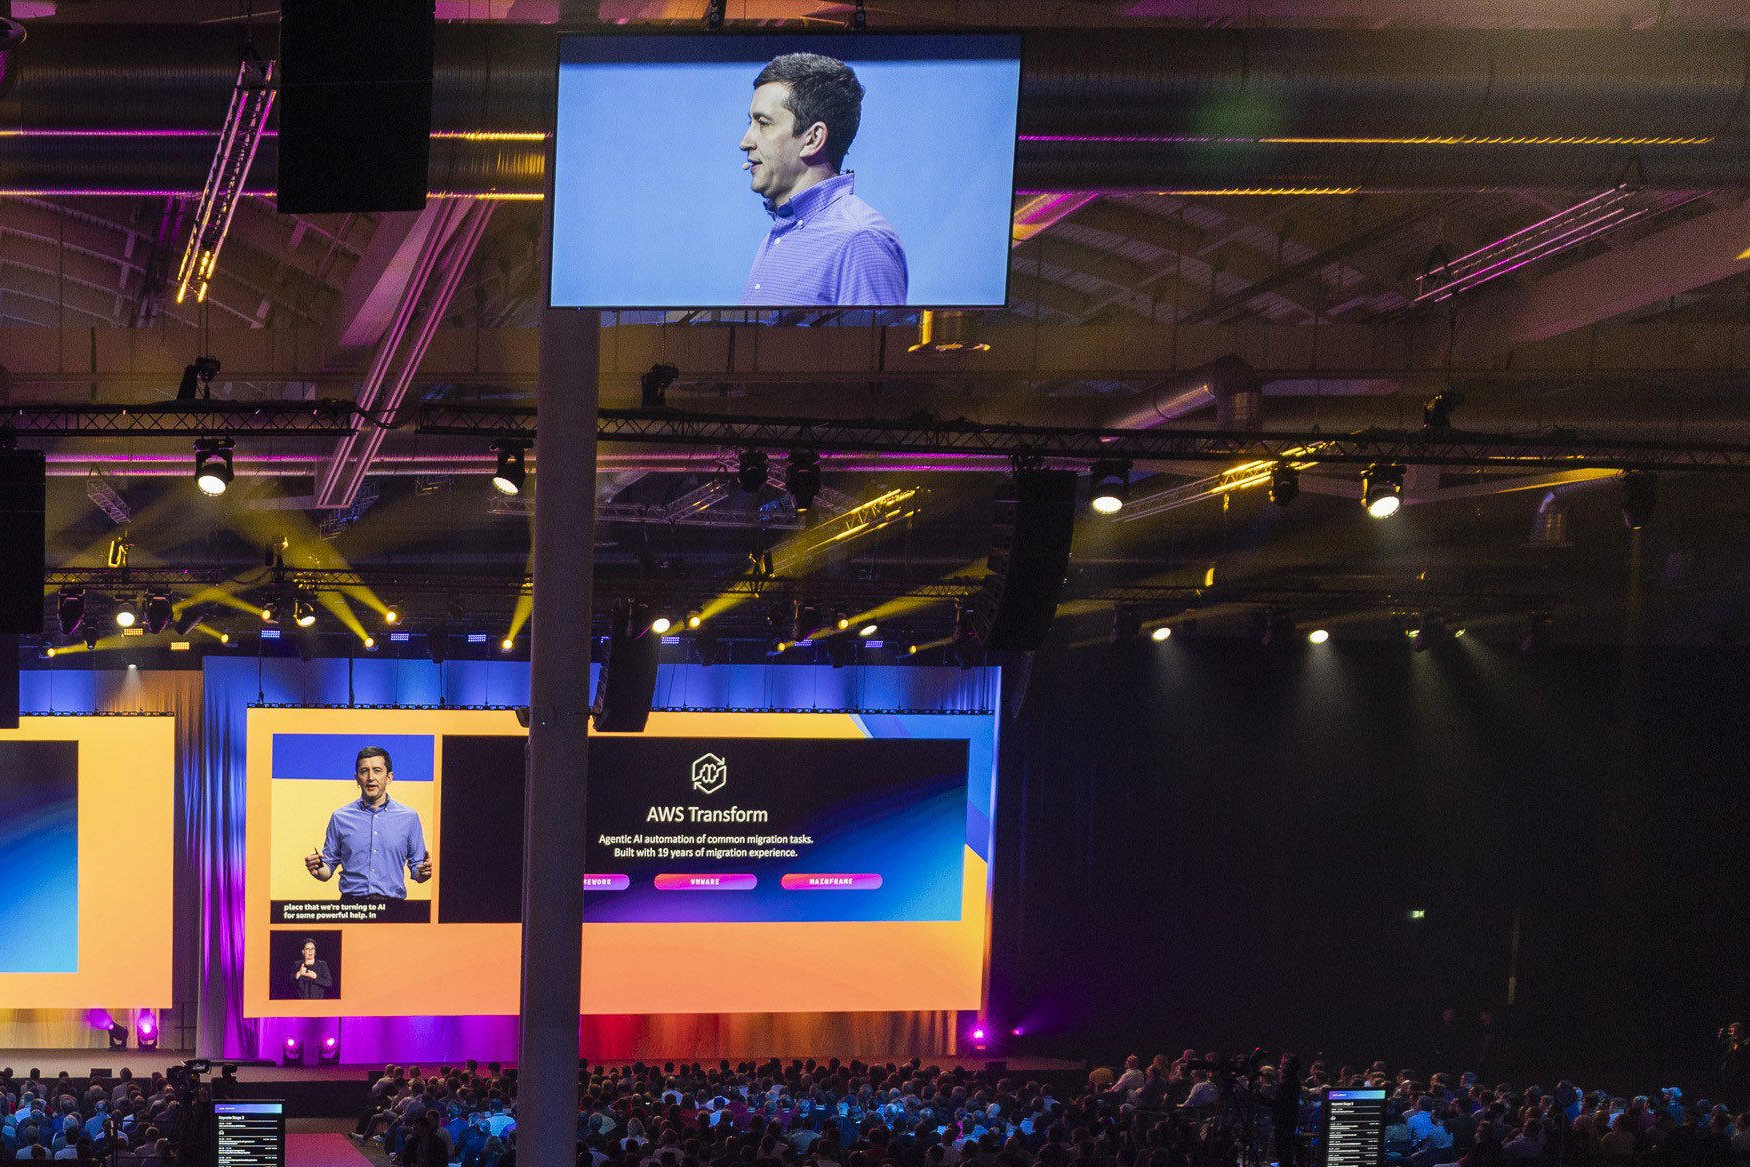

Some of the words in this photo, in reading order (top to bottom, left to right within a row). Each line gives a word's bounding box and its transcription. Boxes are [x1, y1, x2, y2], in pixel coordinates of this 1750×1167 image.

[646, 806, 684, 822] AWS
[688, 806, 768, 822] Transform
[598, 834, 632, 846] Agentic
[633, 834, 643, 844] AI
[644, 834, 695, 844] automation
[696, 834, 706, 844] of
[707, 836, 745, 844] common
[747, 835, 788, 846] migration
[789, 834, 814, 844] tasks.
[614, 847, 635, 857] Built
[636, 847, 656, 857] with
[658, 847, 669, 857] 19
[670, 849, 694, 859] years
[695, 847, 706, 857] of
[706, 848, 747, 859] migration
[749, 848, 798, 859] experience.
[284, 903, 303, 912] place
[341, 903, 368, 912] turning
[283, 911, 295, 919] for
[316, 911, 349, 920] powerful
[349, 911, 368, 920] help.
